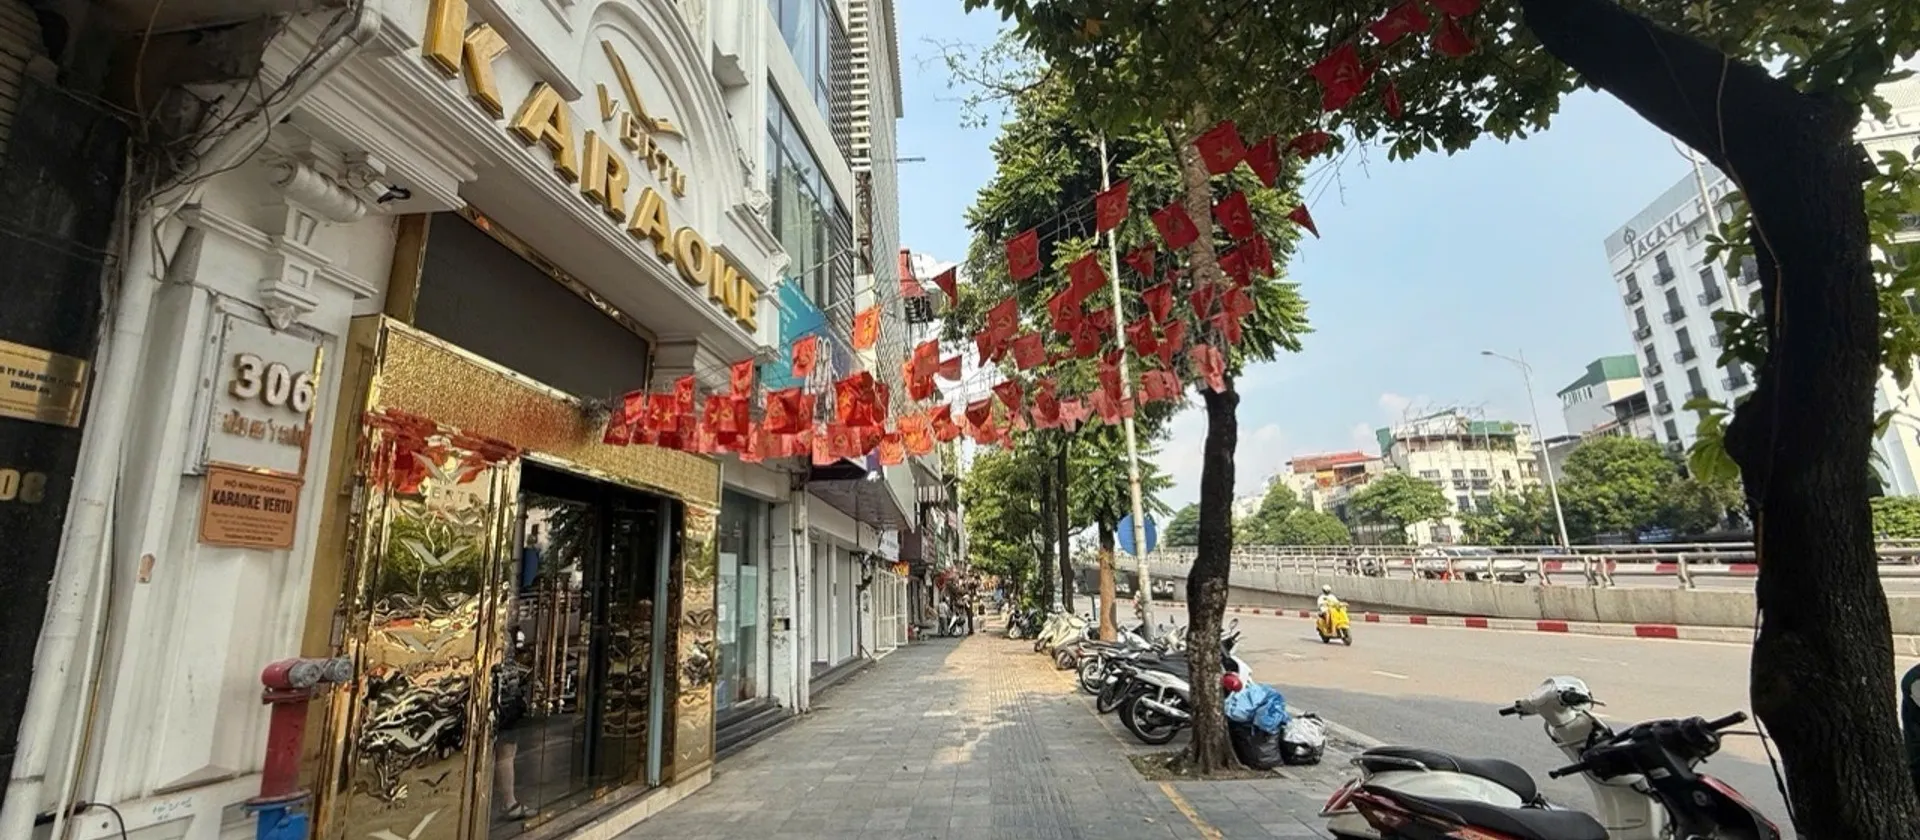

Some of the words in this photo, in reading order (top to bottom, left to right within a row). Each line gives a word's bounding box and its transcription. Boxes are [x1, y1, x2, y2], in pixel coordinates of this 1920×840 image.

[421, 0, 758, 333] KARAOKE
[596, 82, 686, 198] VERTU
[1624, 213, 1687, 262] JACAYL
[228, 352, 316, 413] 306
[211, 488, 261, 510] KARAOKE
[263, 495, 293, 514] VERTU
